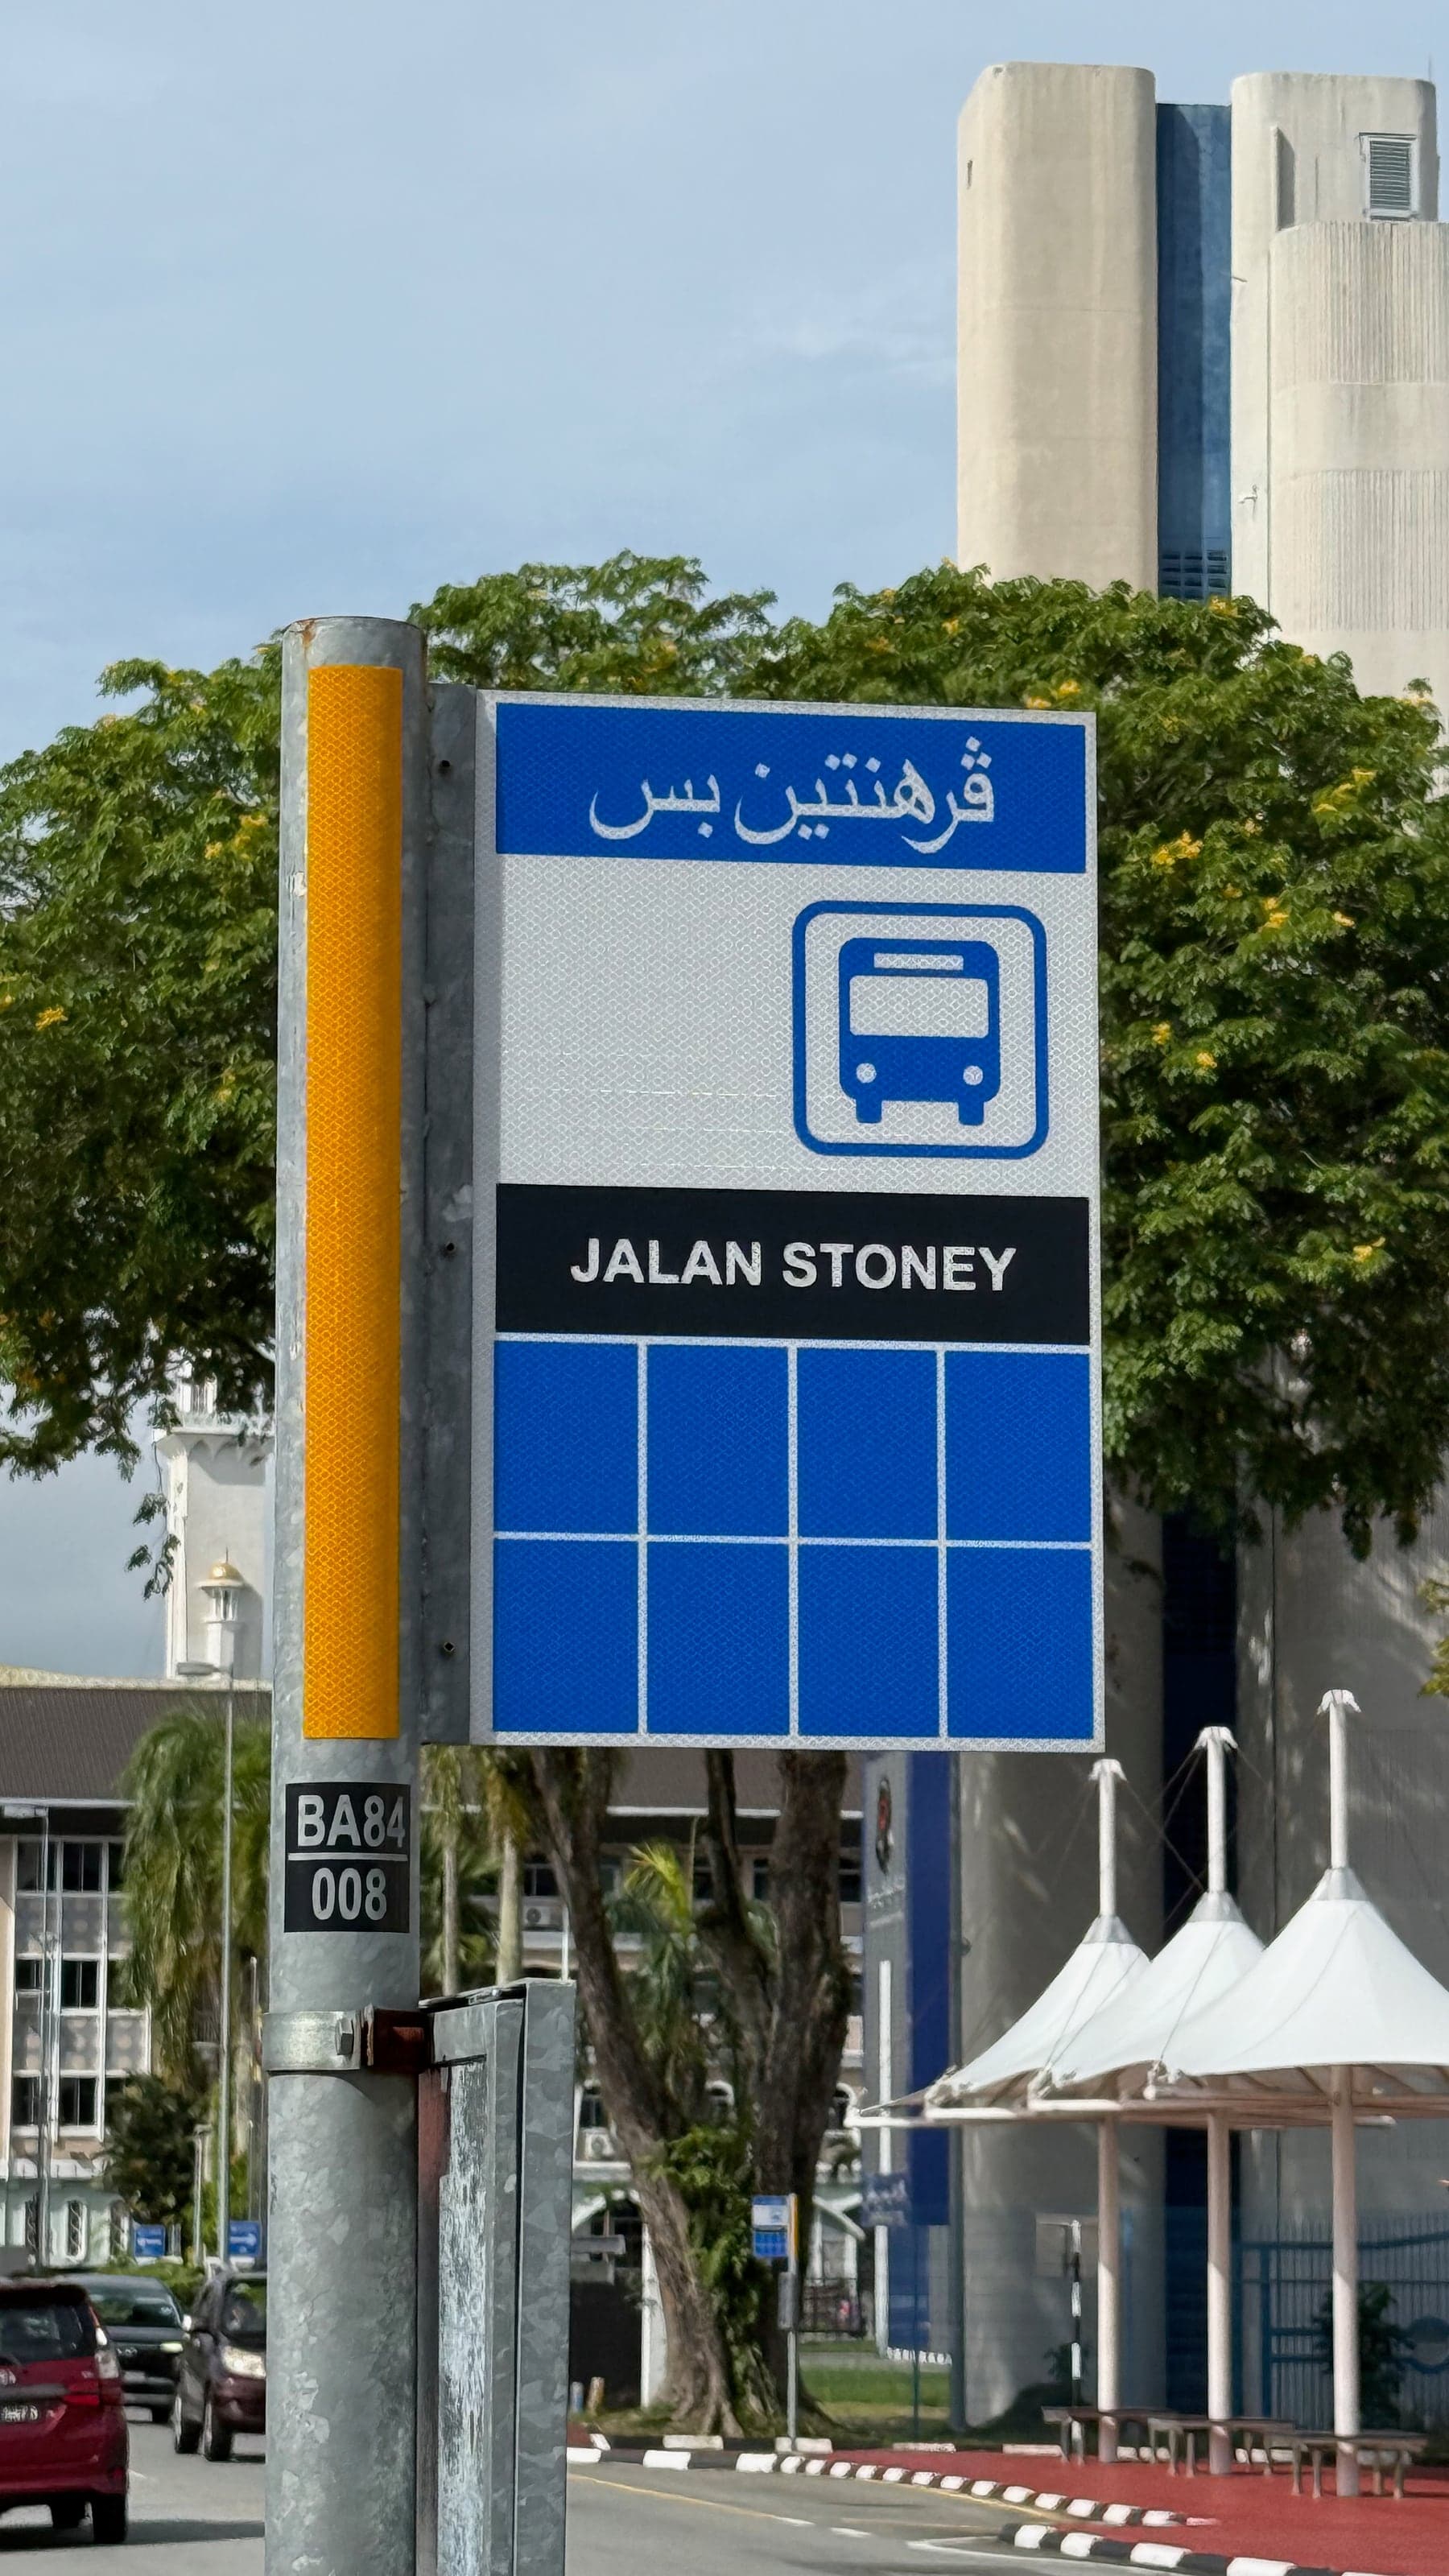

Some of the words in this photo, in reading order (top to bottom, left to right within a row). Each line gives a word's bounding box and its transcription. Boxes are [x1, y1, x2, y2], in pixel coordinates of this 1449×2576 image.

[589, 774, 721, 840] بس
[570, 1237, 761, 1286] JALAN
[782, 1241, 1017, 1291] STONEY
[297, 1794, 406, 1847] BA84
[312, 1867, 387, 1921] 008
